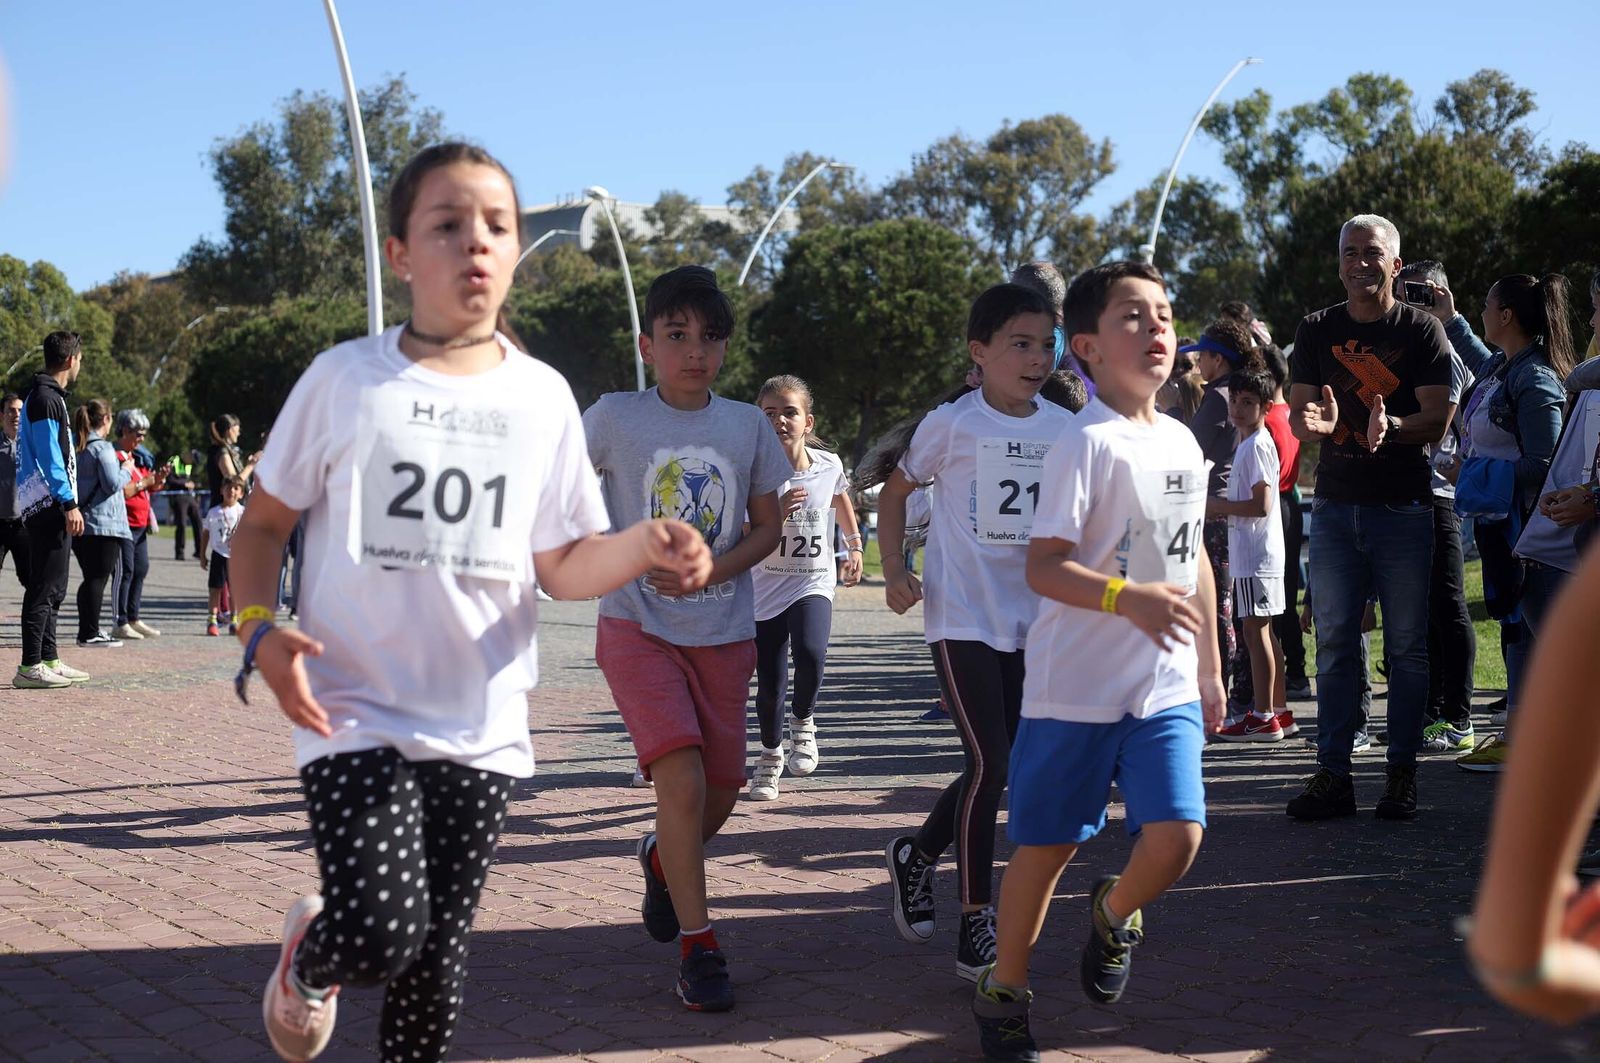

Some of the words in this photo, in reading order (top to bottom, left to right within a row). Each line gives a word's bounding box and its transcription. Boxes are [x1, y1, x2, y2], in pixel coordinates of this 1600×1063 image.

[413, 401, 434, 421] H
[1008, 442, 1021, 454] H
[1166, 475, 1182, 490] H
[387, 462, 506, 528] 201
[998, 480, 1040, 515] 21
[987, 531, 1016, 540] Huelva
[363, 543, 410, 560] Huelva
[780, 535, 822, 558] 125
[764, 564, 783, 573] Huelva
